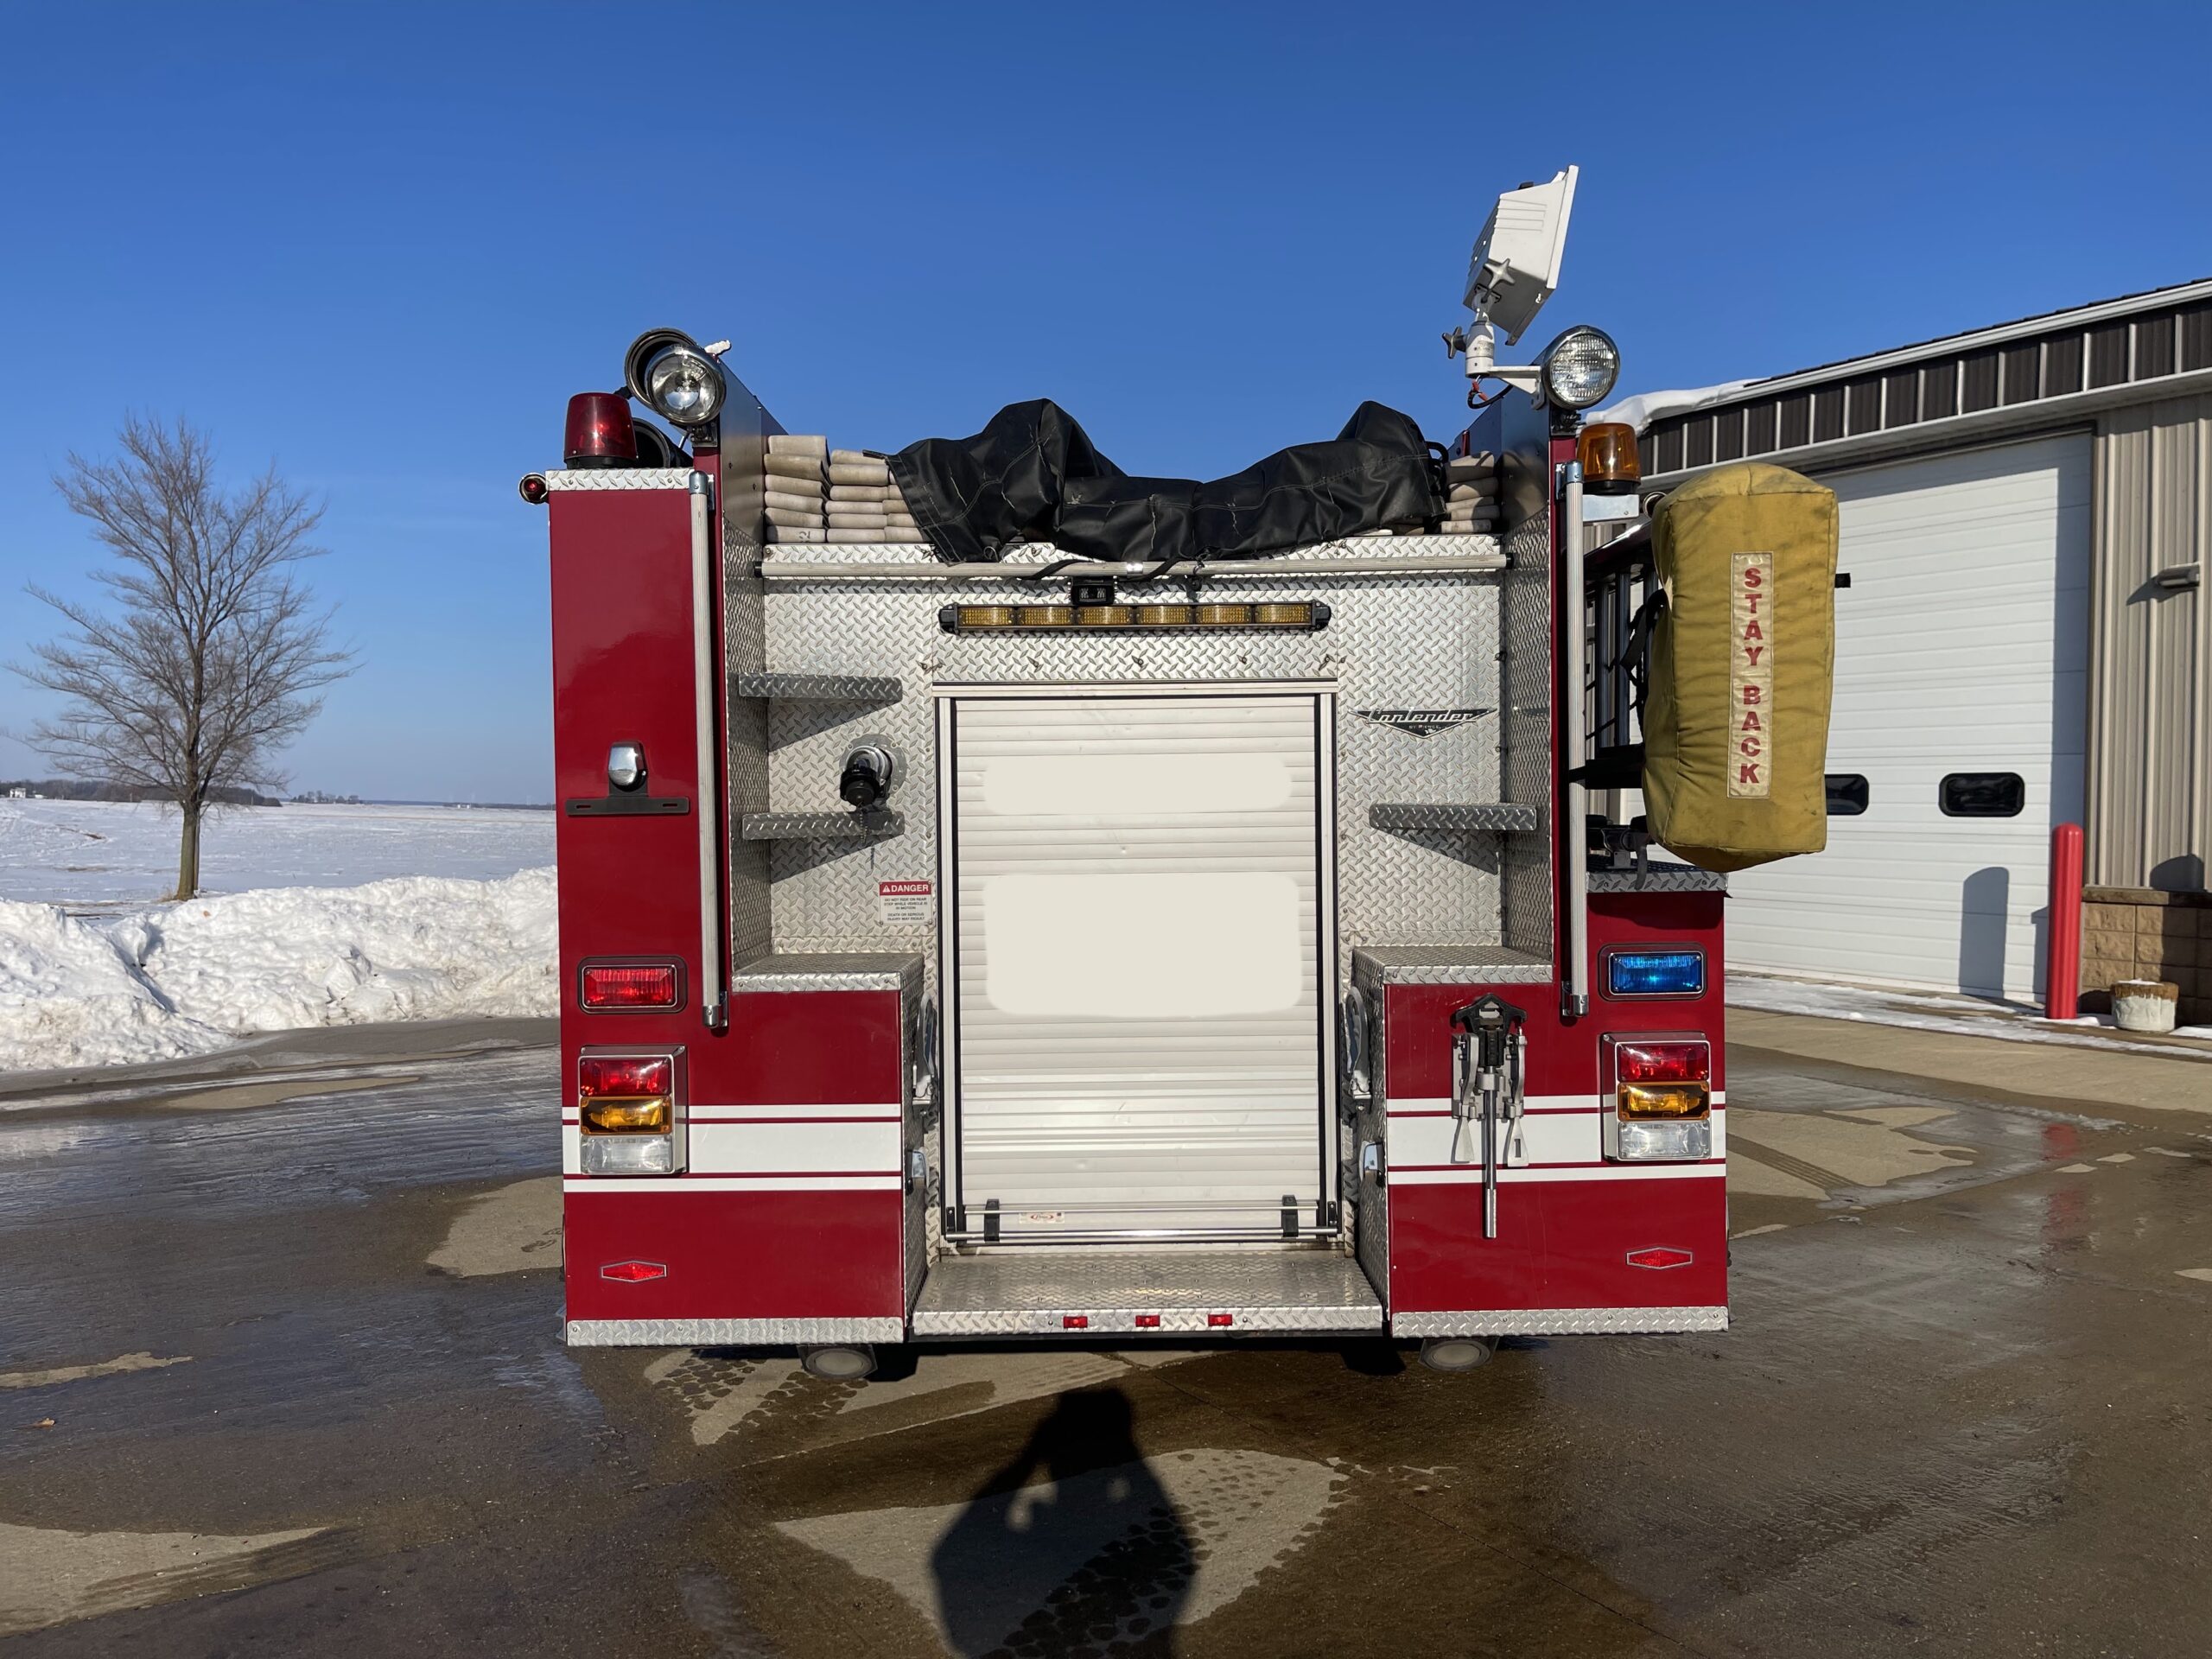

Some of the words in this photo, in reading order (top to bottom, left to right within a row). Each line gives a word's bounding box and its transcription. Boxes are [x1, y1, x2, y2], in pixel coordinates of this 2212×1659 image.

[1744, 567, 1763, 666] STAY
[1368, 708, 1474, 723] Contender
[1739, 684, 1761, 784] BACK
[891, 884, 929, 893] DANGER
